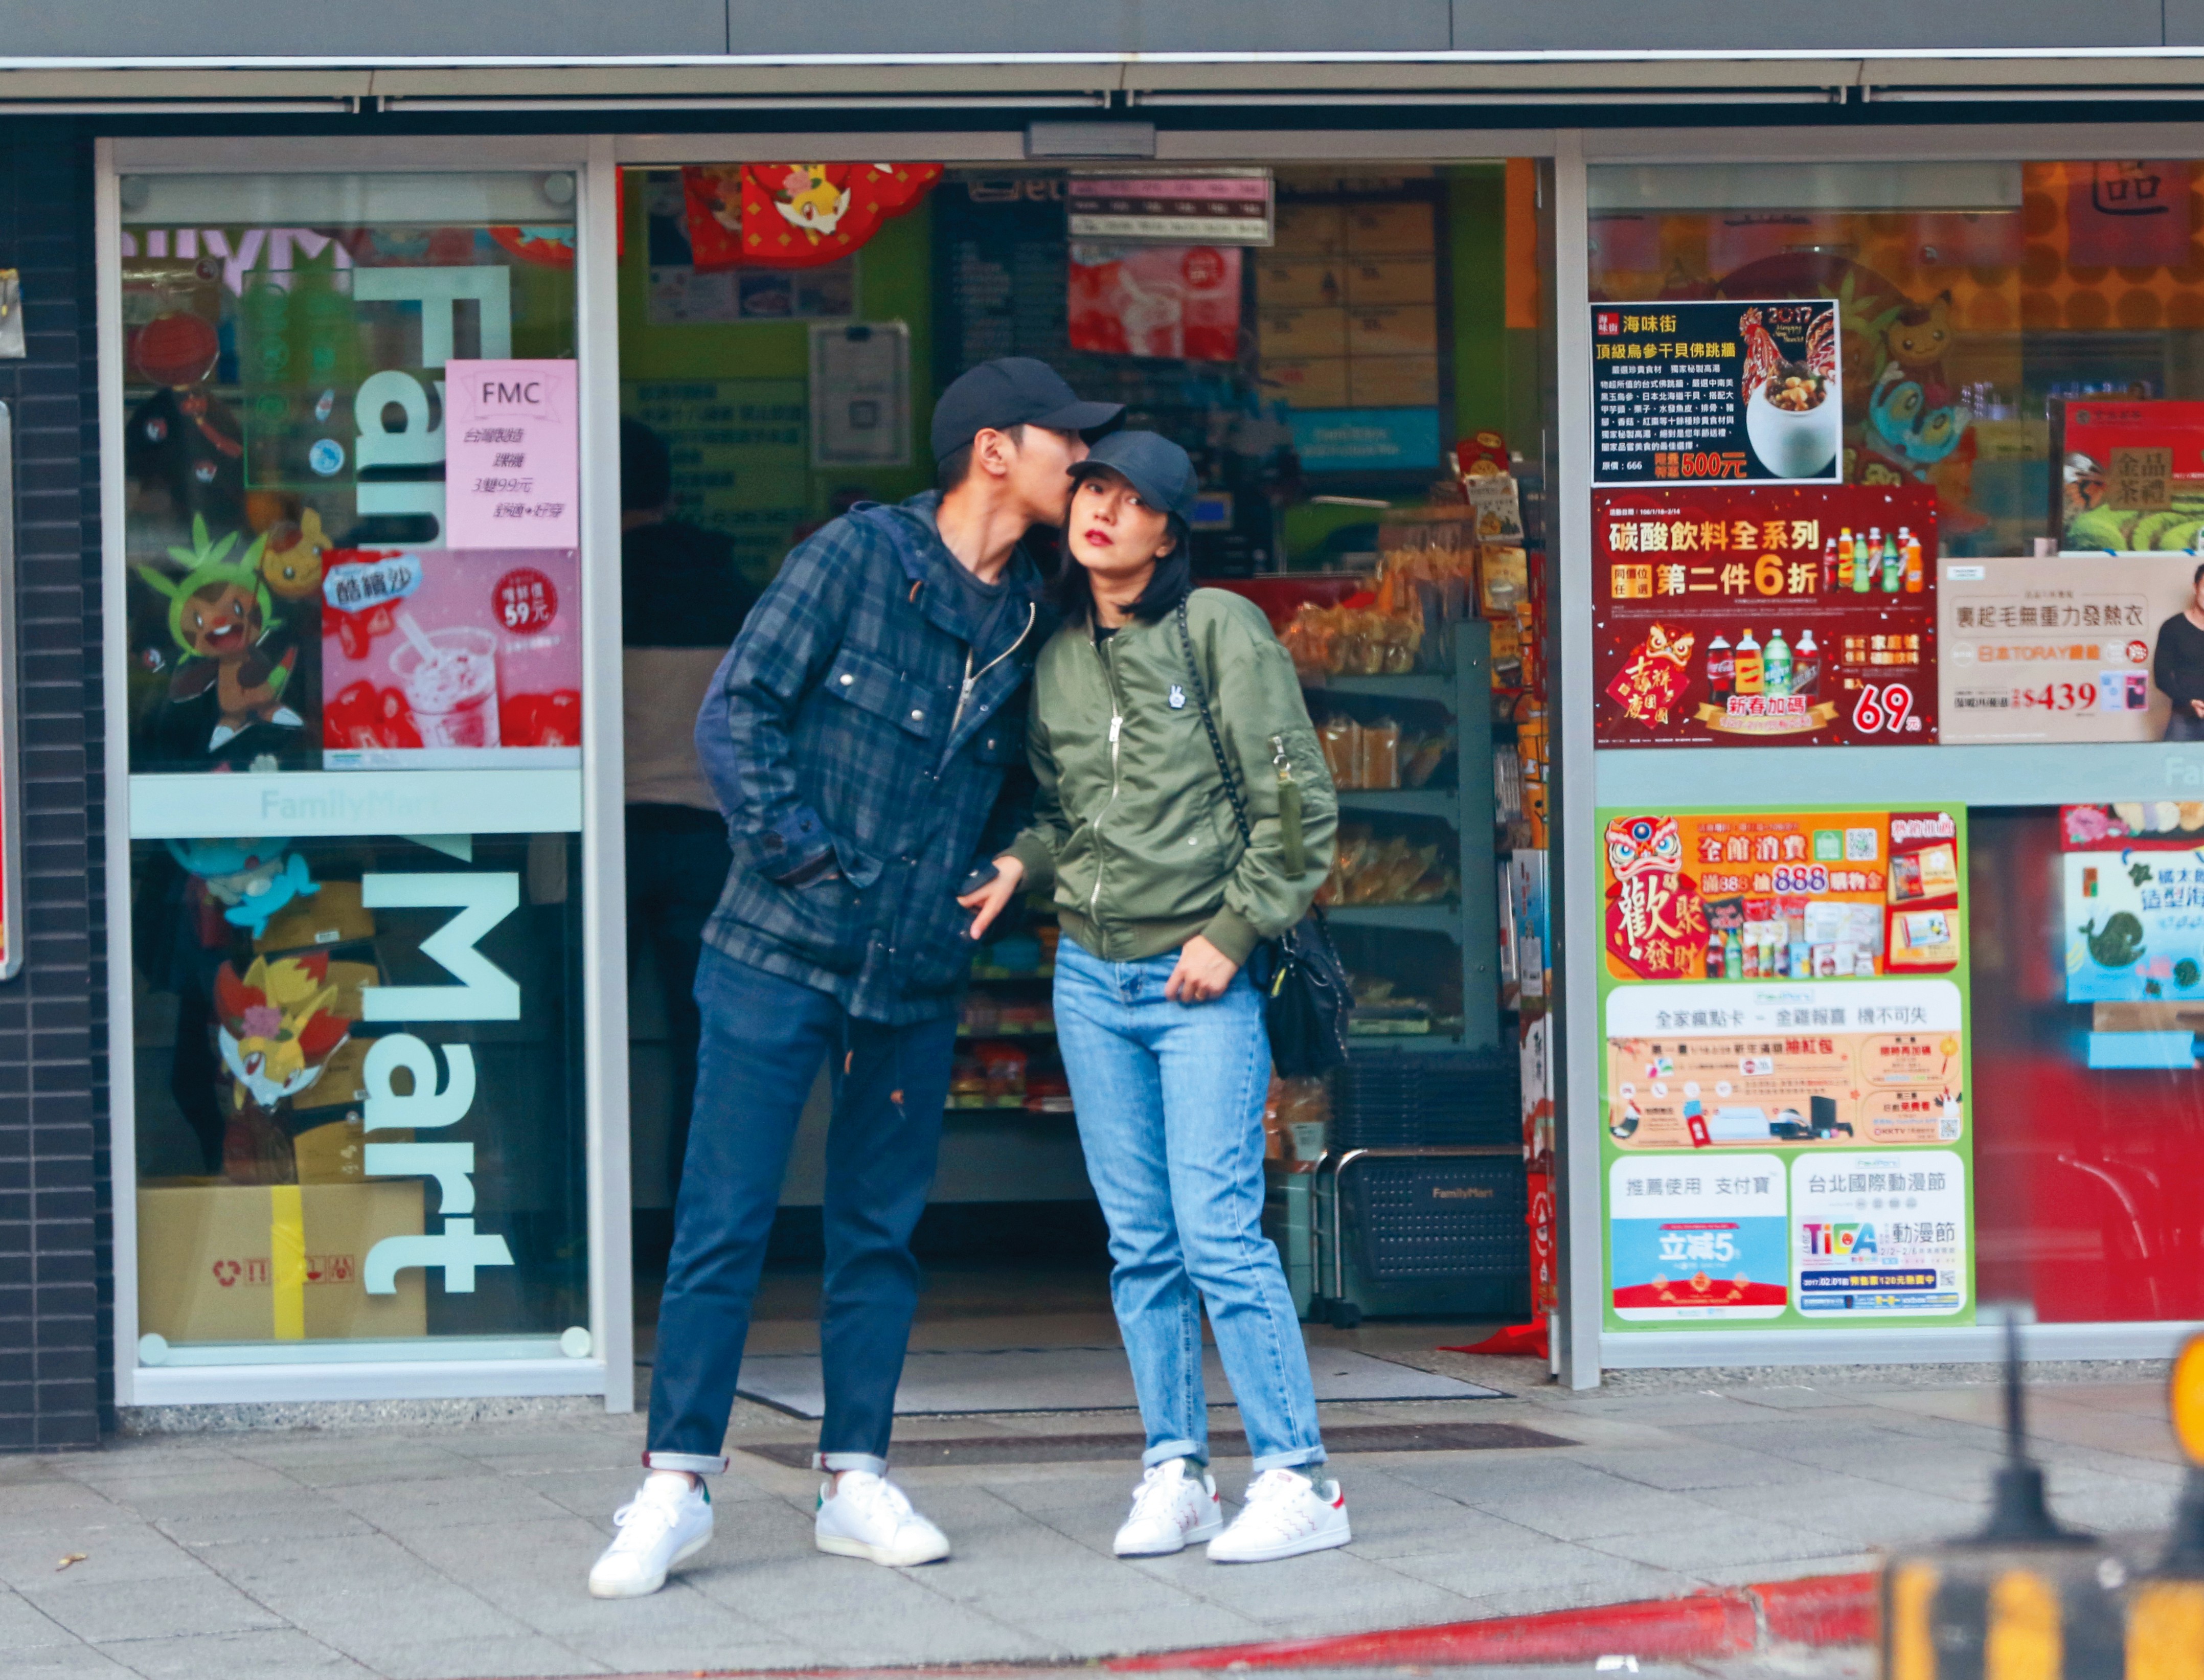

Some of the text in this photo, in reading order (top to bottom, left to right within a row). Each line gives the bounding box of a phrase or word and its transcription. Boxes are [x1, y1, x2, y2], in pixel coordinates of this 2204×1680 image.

[1623, 315, 1676, 333] 海味街
[1767, 306, 1812, 323] 2017
[483, 382, 540, 404] FMC
[1682, 451, 1747, 479] 500元
[1608, 519, 1820, 552] 碳酸飲料全系列
[1656, 554, 1819, 596] 第二件6折
[1726, 694, 1807, 716] 新春加碼
[2021, 683, 2096, 710] $439
[1433, 1187, 1494, 1199] FamilyMart
[1809, 1172, 1946, 1193] 台北國際動漫節
[1893, 1222, 1955, 1244] 動漫節
